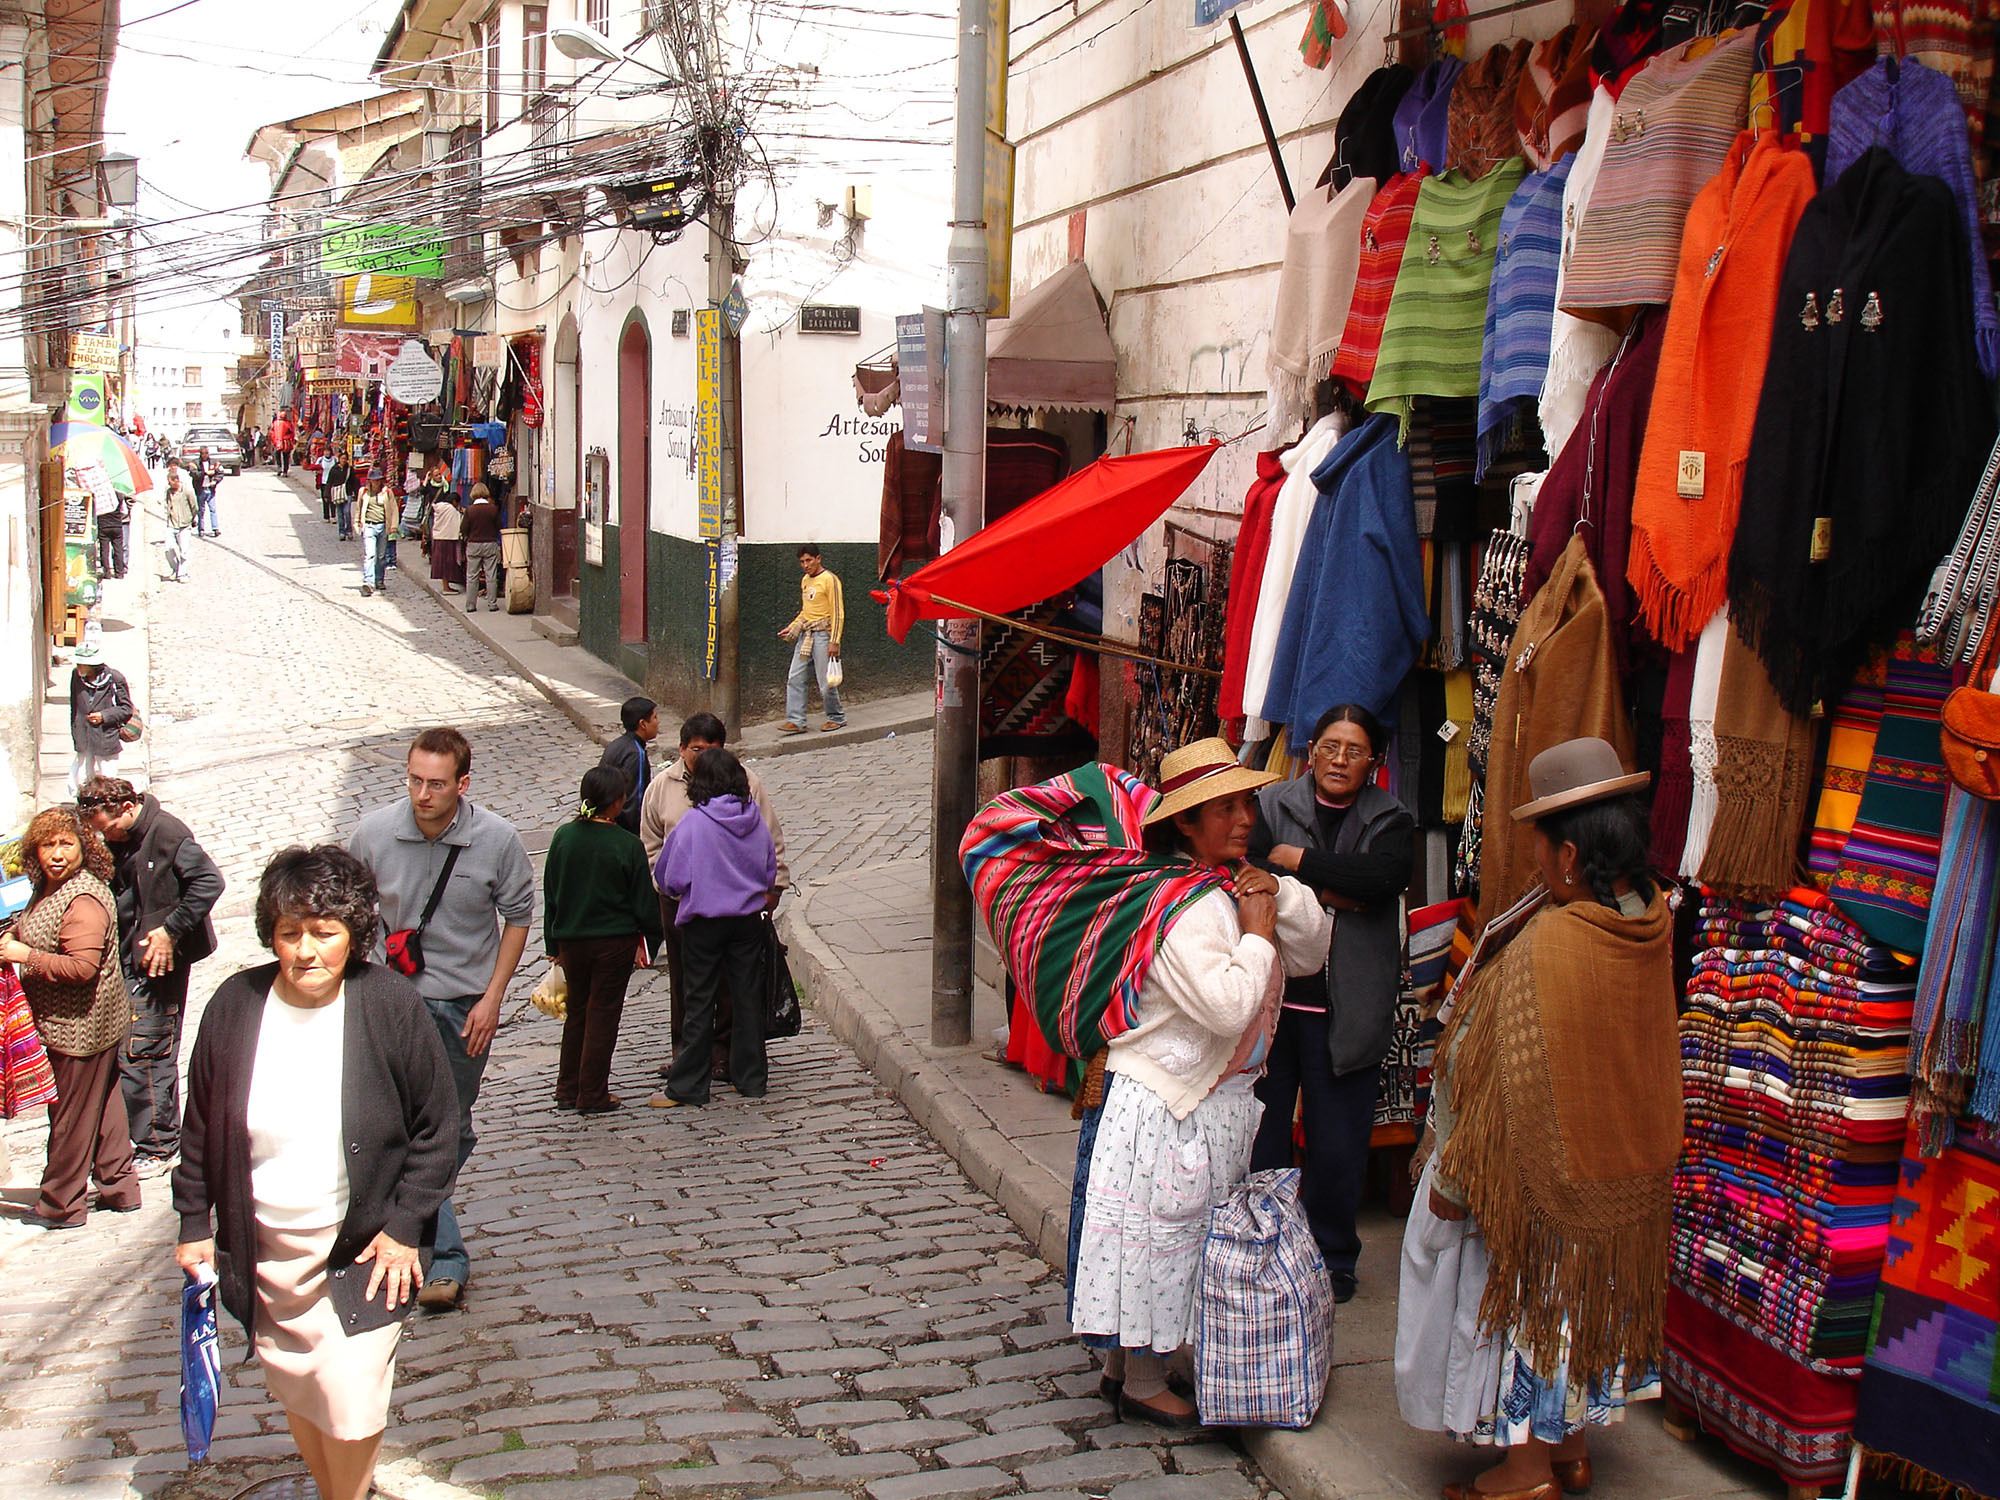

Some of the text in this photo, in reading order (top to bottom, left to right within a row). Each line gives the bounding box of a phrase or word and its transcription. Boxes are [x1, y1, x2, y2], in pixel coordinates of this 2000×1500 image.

[272, 313, 282, 360] ARTESANAL
[814, 309, 848, 319] CALLE
[698, 313, 709, 501] CALL CENTER
[710, 312, 720, 502] INTERNATIONAL
[706, 551, 717, 678] LAUNDRY
